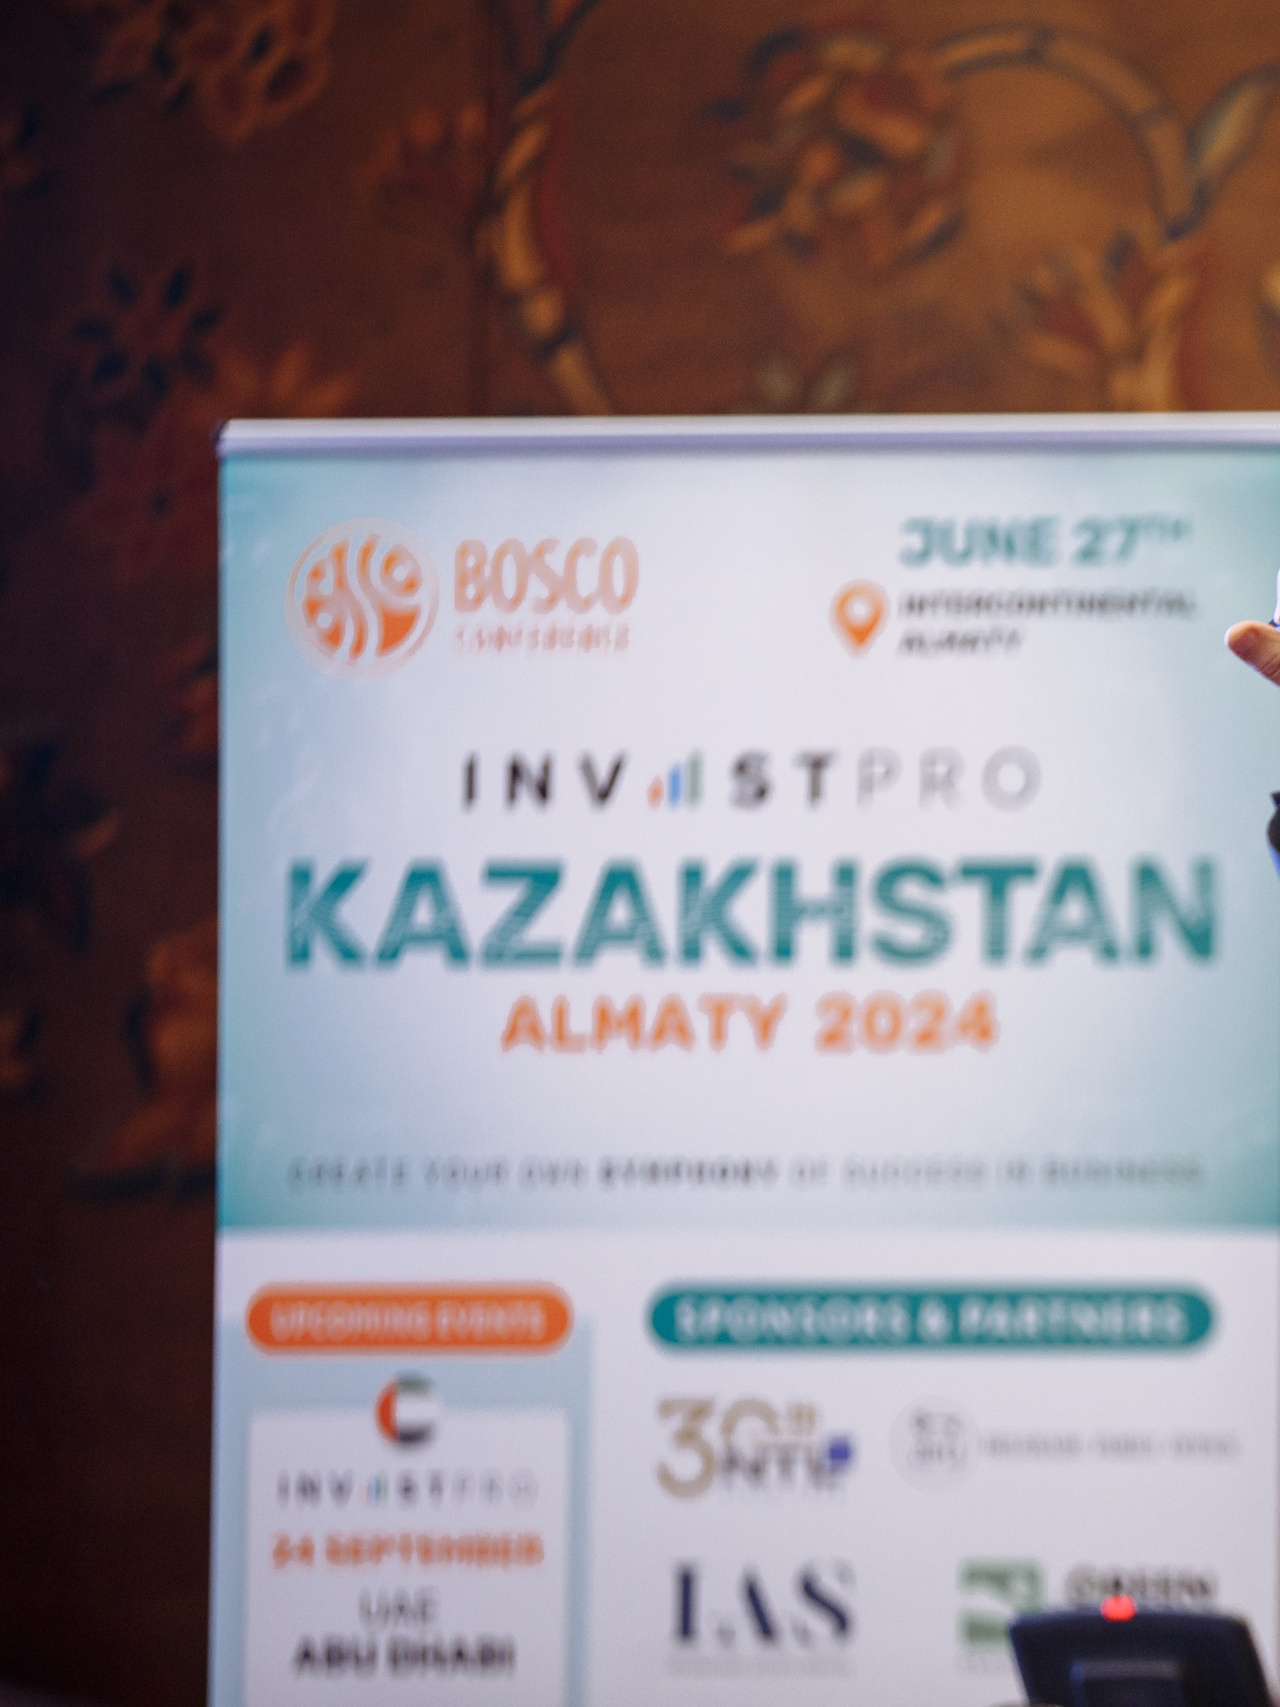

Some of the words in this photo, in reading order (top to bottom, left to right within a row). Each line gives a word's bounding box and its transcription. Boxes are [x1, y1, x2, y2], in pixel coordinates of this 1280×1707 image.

[900, 517, 1060, 568] JUNE
[454, 536, 639, 615] BOSCO
[899, 626, 1021, 656] ALMATY
[286, 858, 1217, 968] KAZAKHSTAN
[501, 993, 787, 1054] ALMATY
[815, 989, 999, 1055] 2024
[290, 1157, 409, 1191] CREATE
[424, 1157, 507, 1191] YOUR
[520, 1157, 587, 1190] OWN
[600, 1156, 778, 1190] SYMPHONY
[787, 1156, 830, 1189] OF
[270, 1301, 433, 1343] UPCOMING
[435, 1301, 547, 1342] EVENTS
[674, 1298, 916, 1344] SPONSORS
[918, 1300, 954, 1343] &
[958, 1299, 1190, 1344] PARTNERS
[273, 1532, 314, 1570] 24
[326, 1531, 545, 1569] SEPTEMBER
[359, 1588, 434, 1628] UAE
[294, 1635, 378, 1678] ABU
[388, 1634, 516, 1678] DHABI
